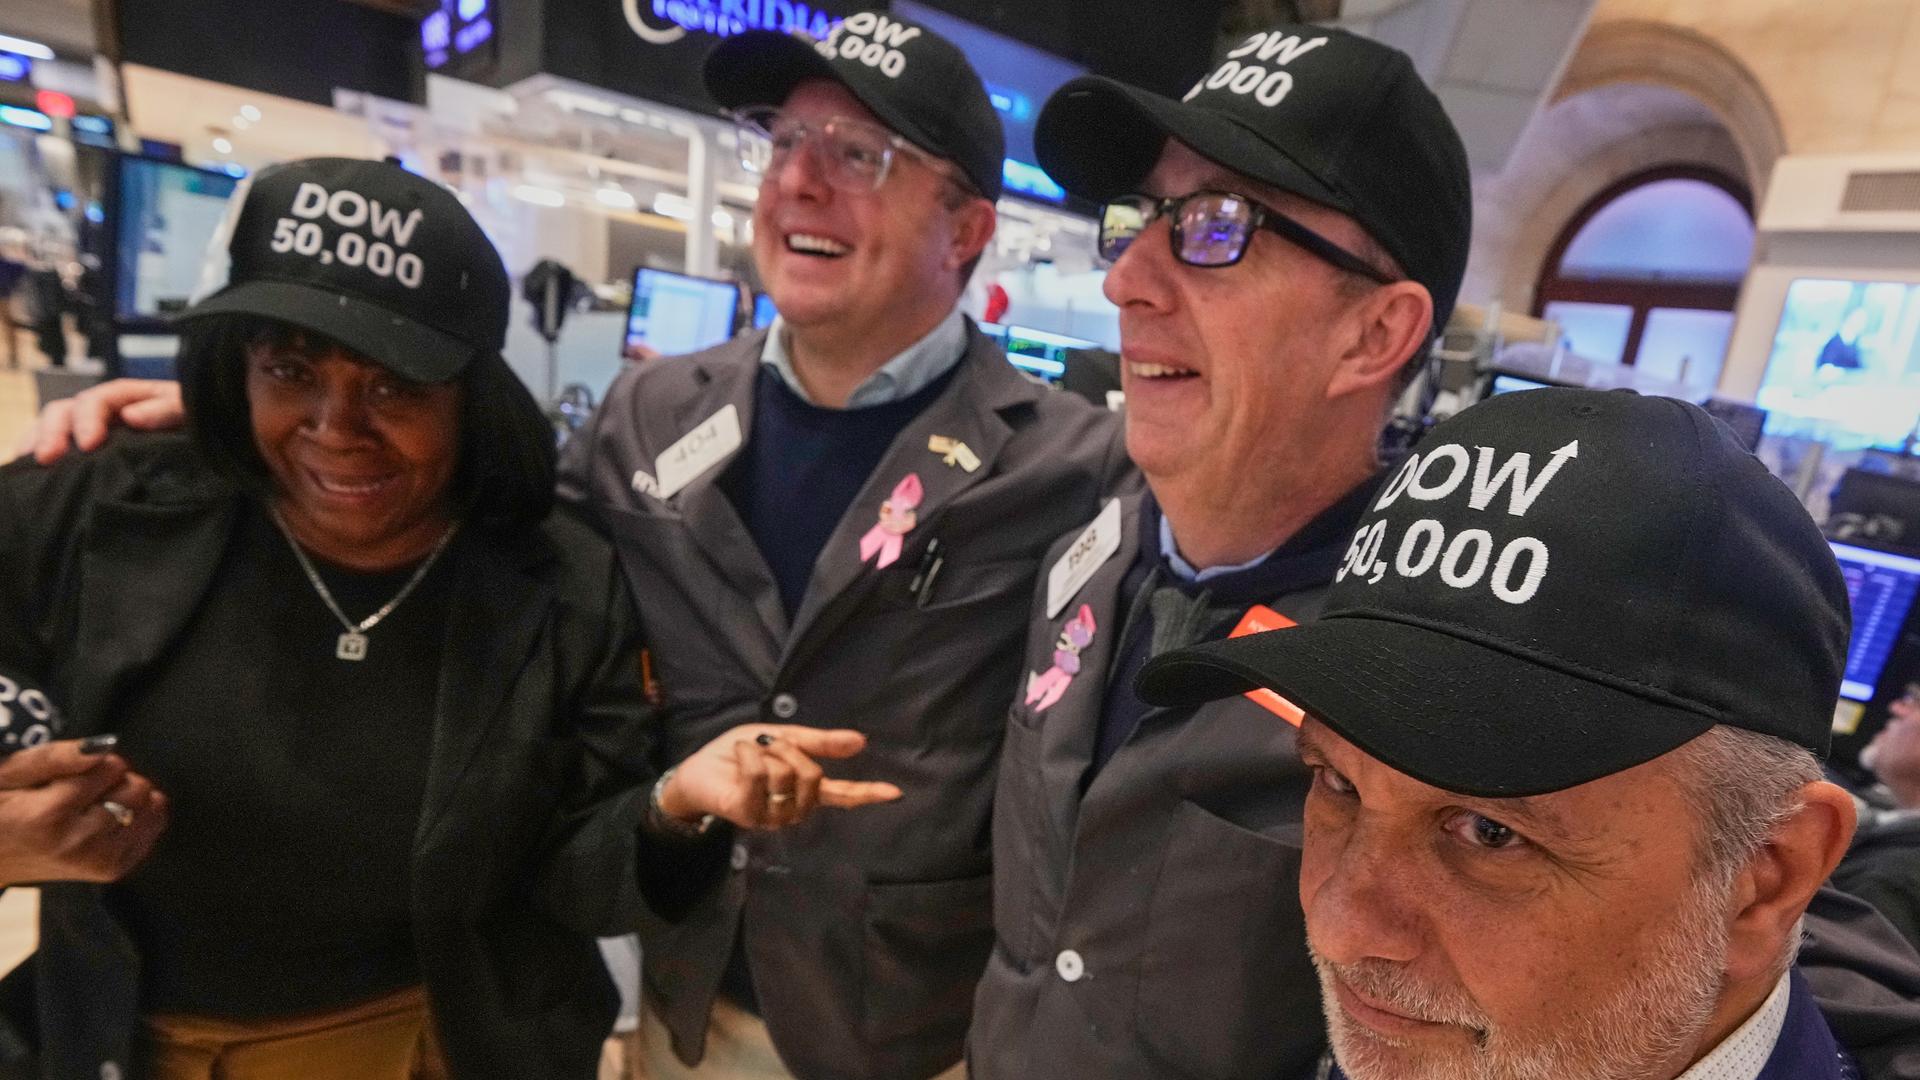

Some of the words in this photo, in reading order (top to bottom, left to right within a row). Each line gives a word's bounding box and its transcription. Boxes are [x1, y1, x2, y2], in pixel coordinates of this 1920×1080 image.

[844, 12, 921, 48] OW
[291, 182, 423, 247] DOW
[271, 218, 424, 288] 50,000
[1373, 439, 1579, 517] DOW
[1336, 519, 1549, 604] 50,000
